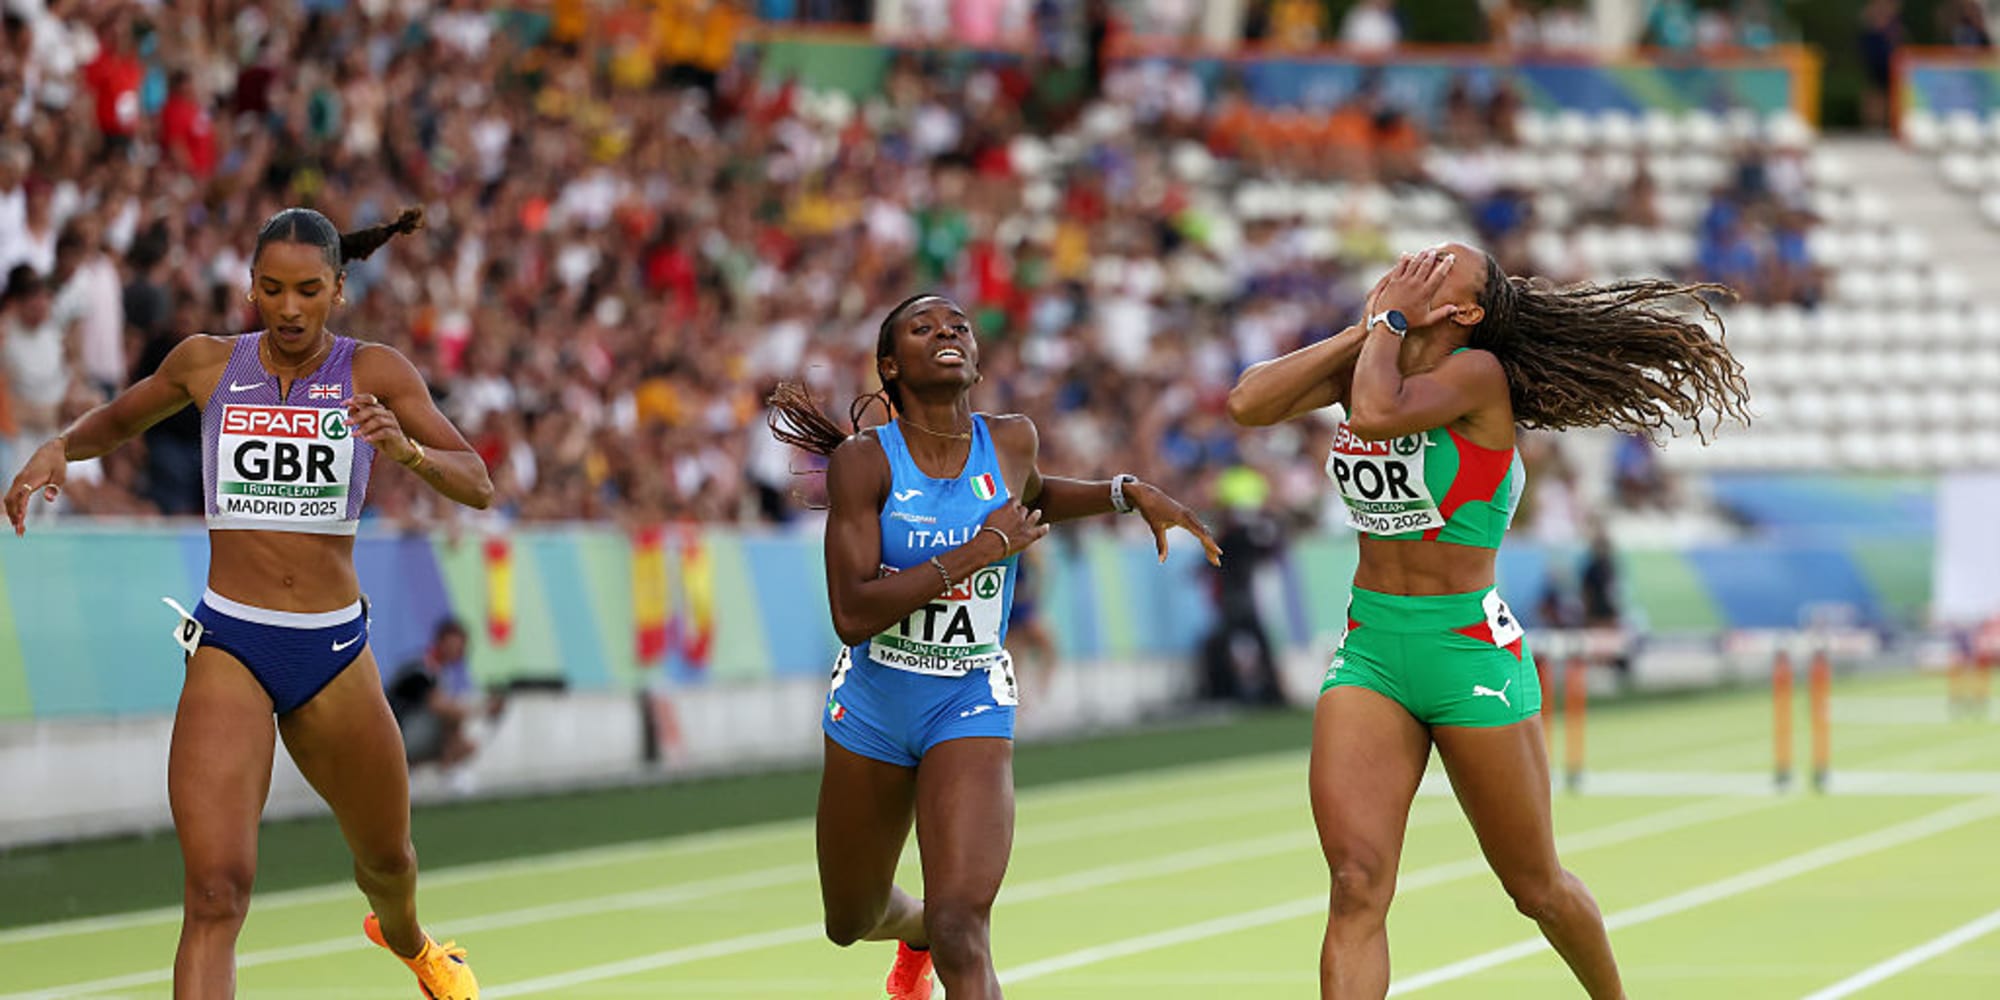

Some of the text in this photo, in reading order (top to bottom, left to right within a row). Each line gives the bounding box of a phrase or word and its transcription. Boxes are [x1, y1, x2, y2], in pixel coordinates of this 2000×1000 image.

[226, 410, 316, 434] SPAR
[233, 439, 338, 483] GBR
[1333, 456, 1420, 500] POR
[249, 484, 276, 496] RUN
[278, 485, 319, 497] CLEAN
[227, 498, 337, 516] MADRID 2025
[1392, 512, 1432, 529] 2025
[899, 604, 976, 644] ITA
[930, 645, 970, 658] CLEAN
